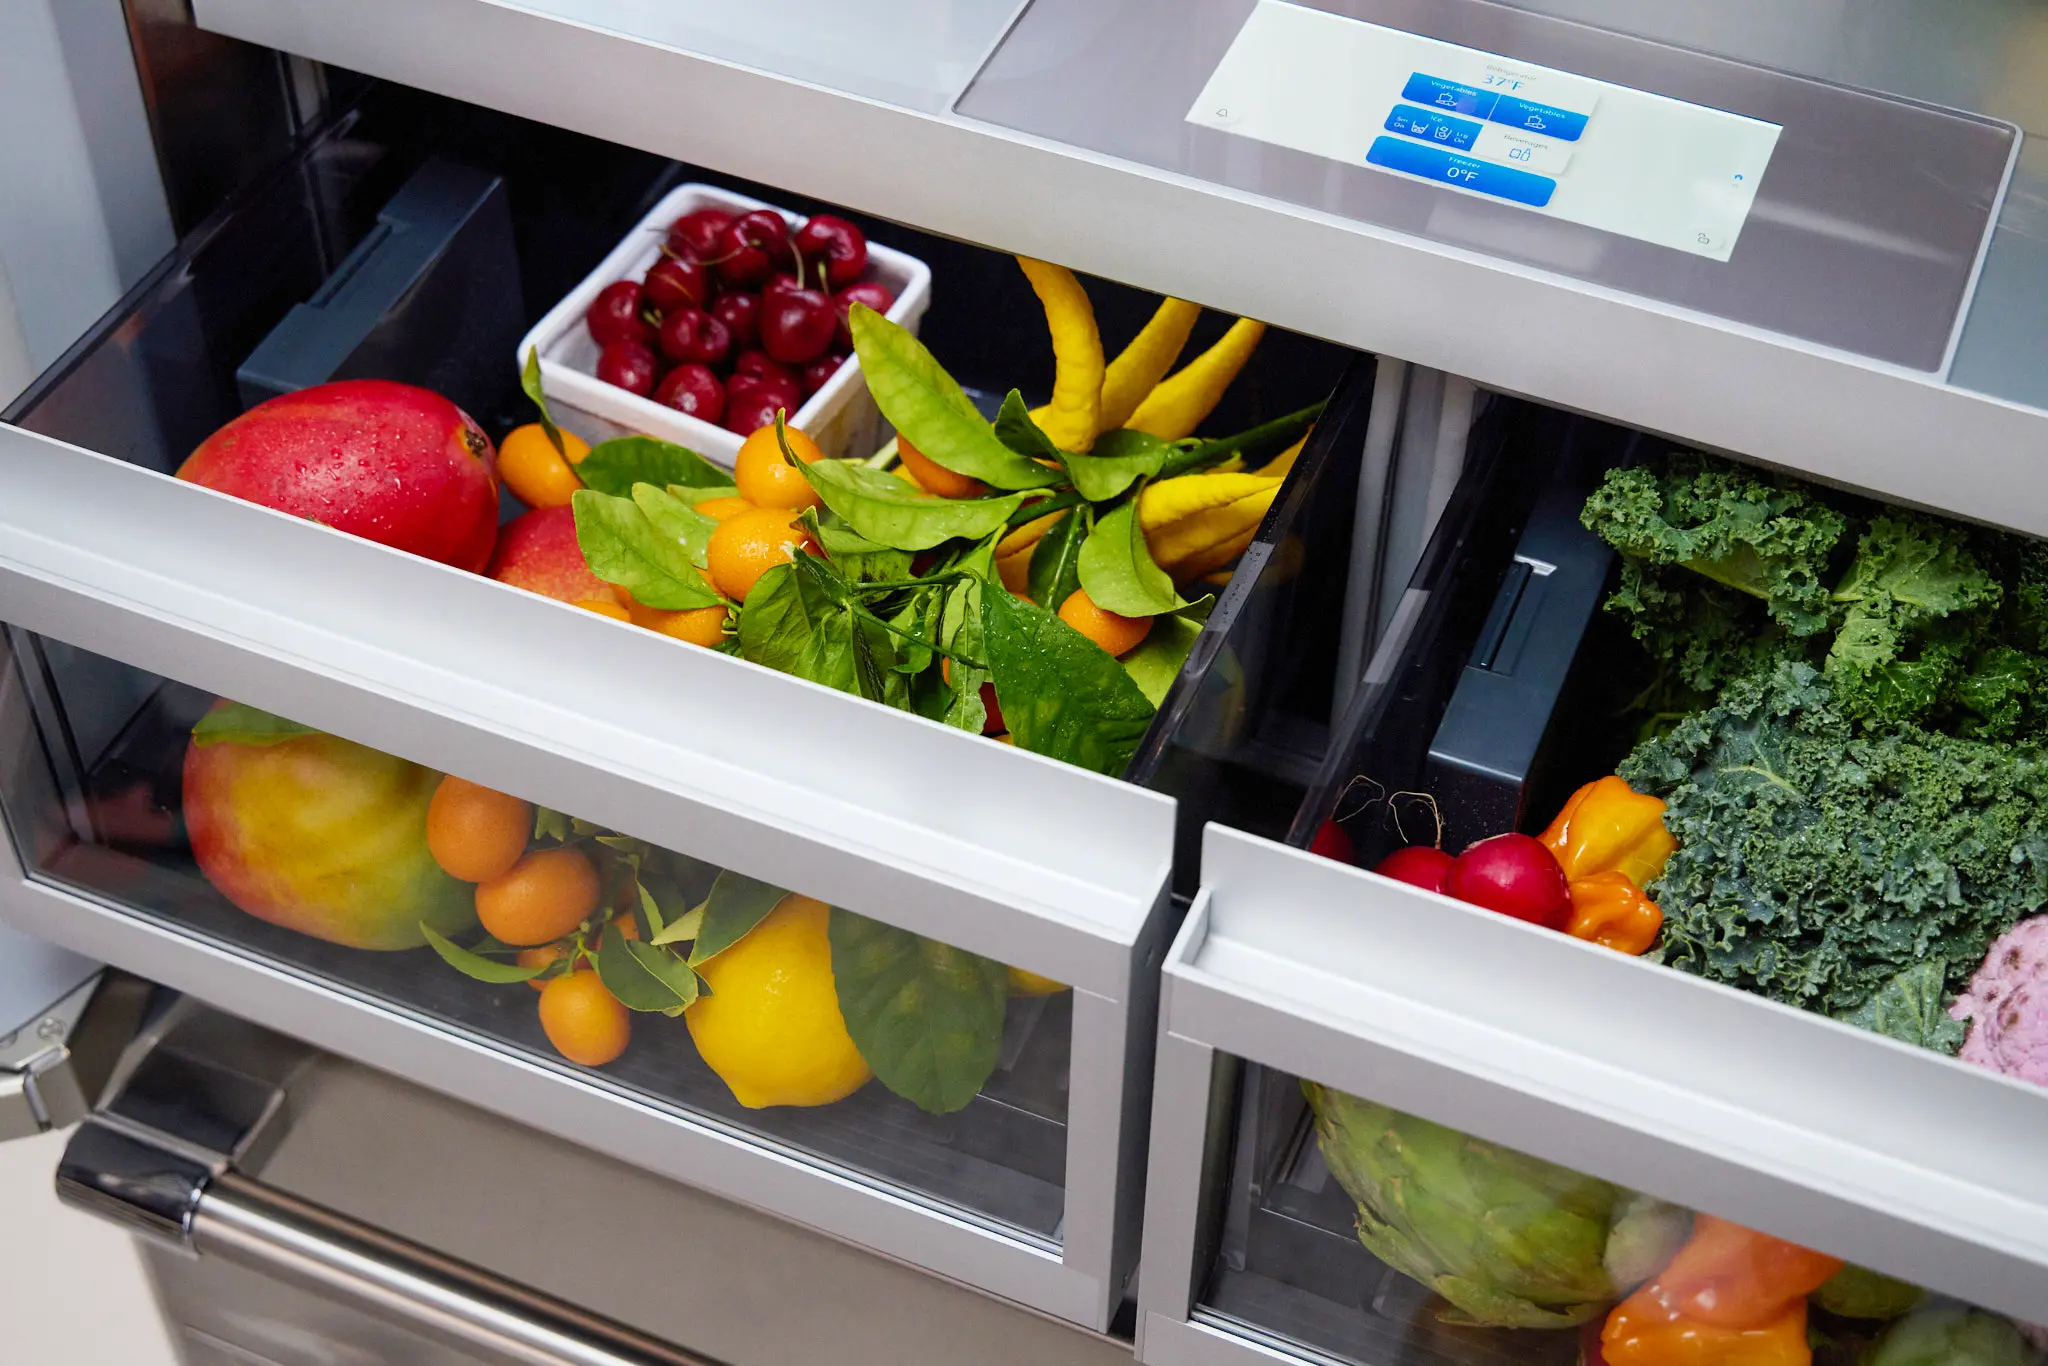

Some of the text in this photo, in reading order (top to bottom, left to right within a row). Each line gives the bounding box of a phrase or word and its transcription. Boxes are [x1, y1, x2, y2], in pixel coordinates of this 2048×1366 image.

[1431, 80, 1477, 97] Vegetables
[1519, 102, 1566, 119] Vegetables
[1430, 115, 1443, 123] Ice
[1504, 134, 1548, 150] Beverages
[1448, 156, 1481, 169] Freezer
[1447, 167, 1479, 182] 0°F
